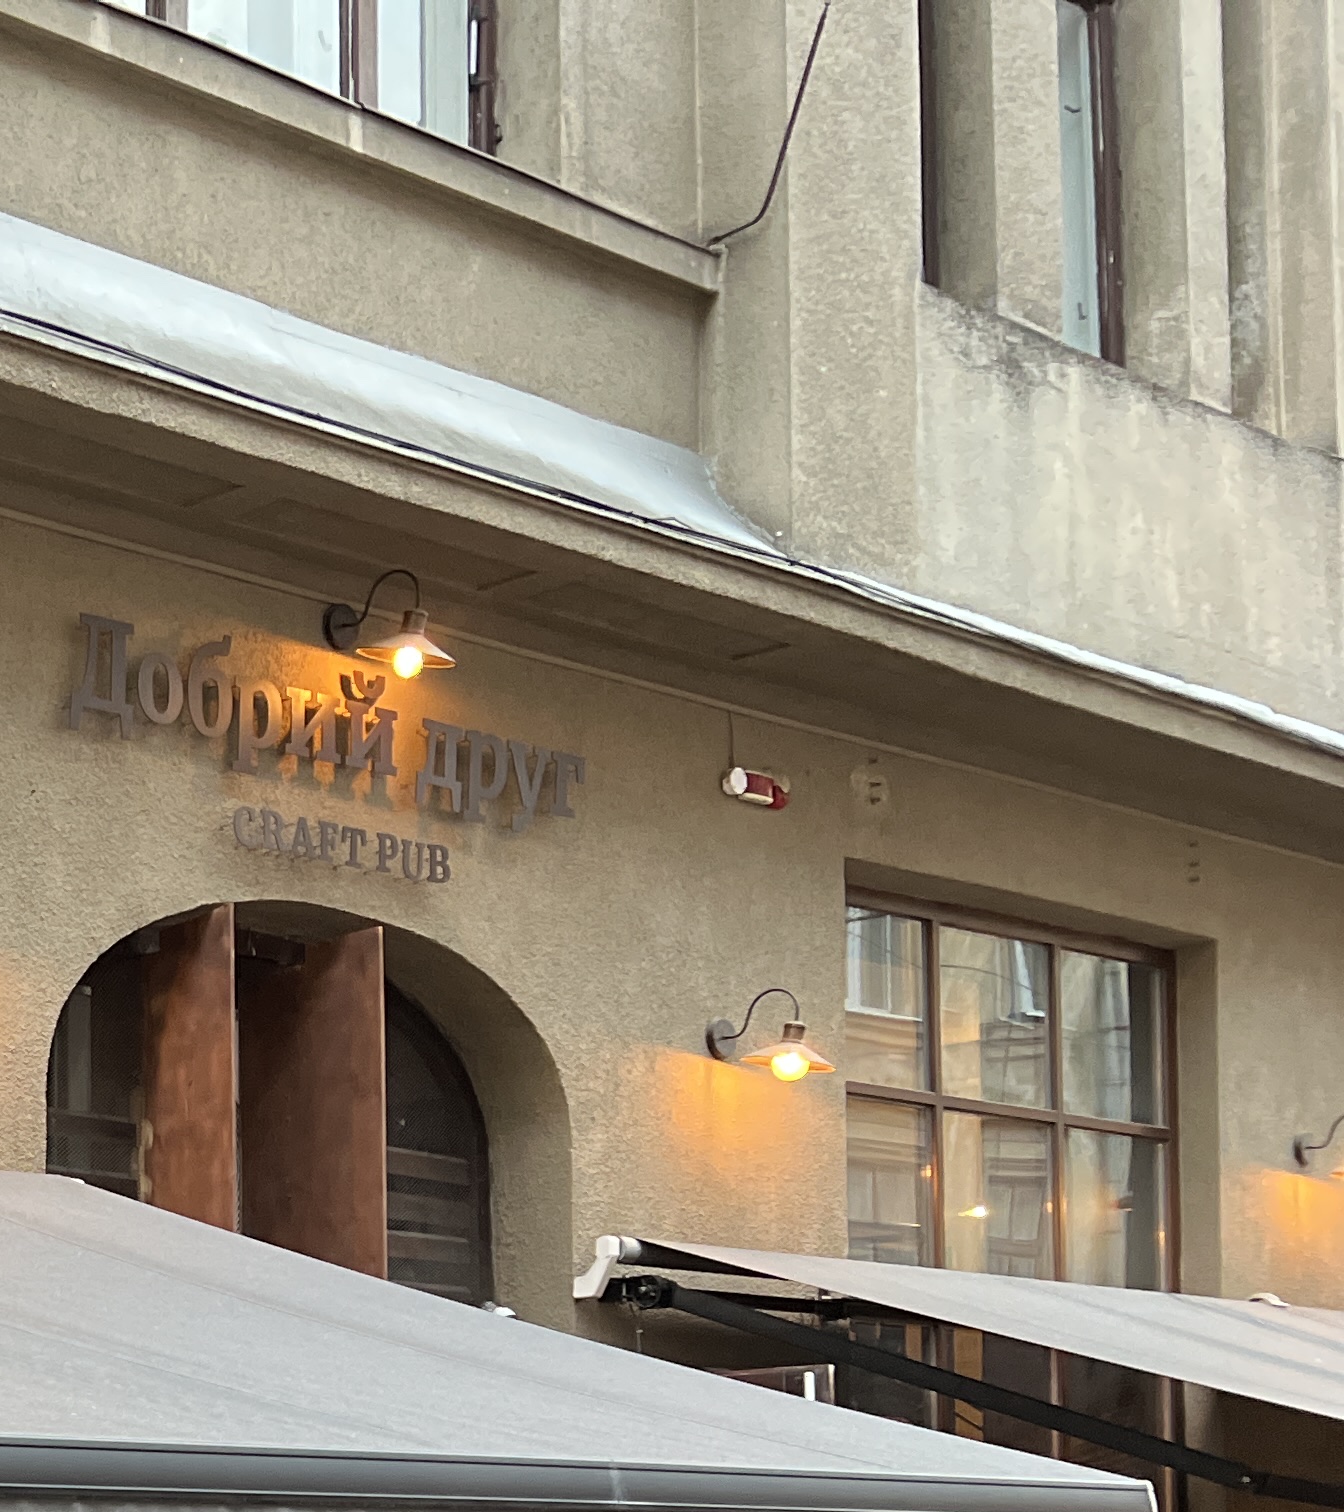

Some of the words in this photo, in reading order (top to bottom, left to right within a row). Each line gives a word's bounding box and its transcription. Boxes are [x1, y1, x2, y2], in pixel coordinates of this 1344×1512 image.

[68, 612, 398, 776] Добрий
[416, 718, 587, 832] друг
[233, 806, 367, 869] CRAFT
[376, 831, 452, 884] PUB
